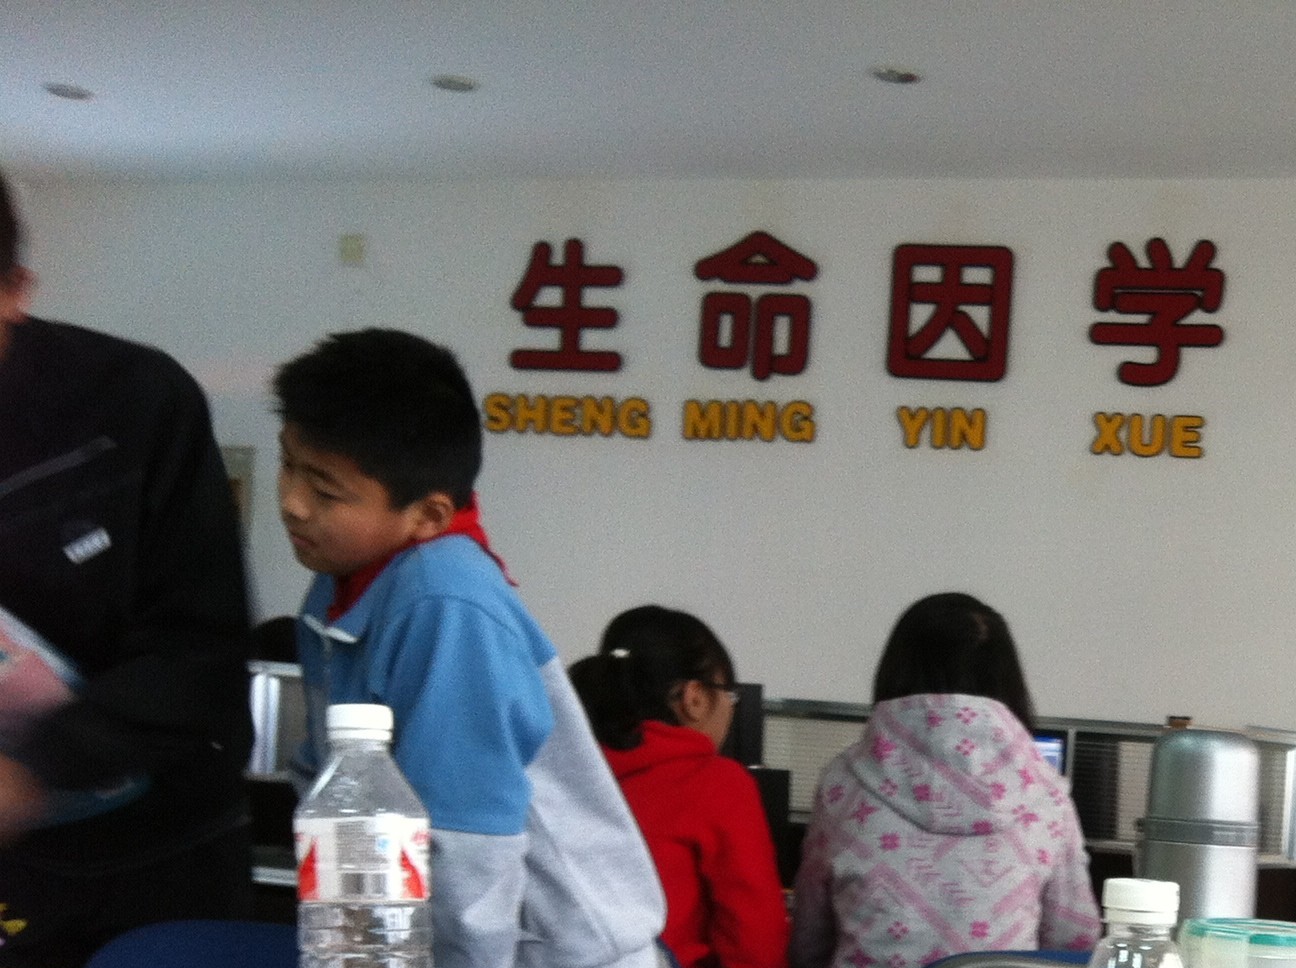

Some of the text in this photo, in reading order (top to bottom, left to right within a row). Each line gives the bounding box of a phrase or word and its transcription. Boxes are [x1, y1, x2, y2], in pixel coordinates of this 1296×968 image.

[484, 391, 652, 439] SHENG
[683, 399, 816, 443] MING
[896, 406, 987, 450] YIN
[1090, 412, 1205, 459] XUE
